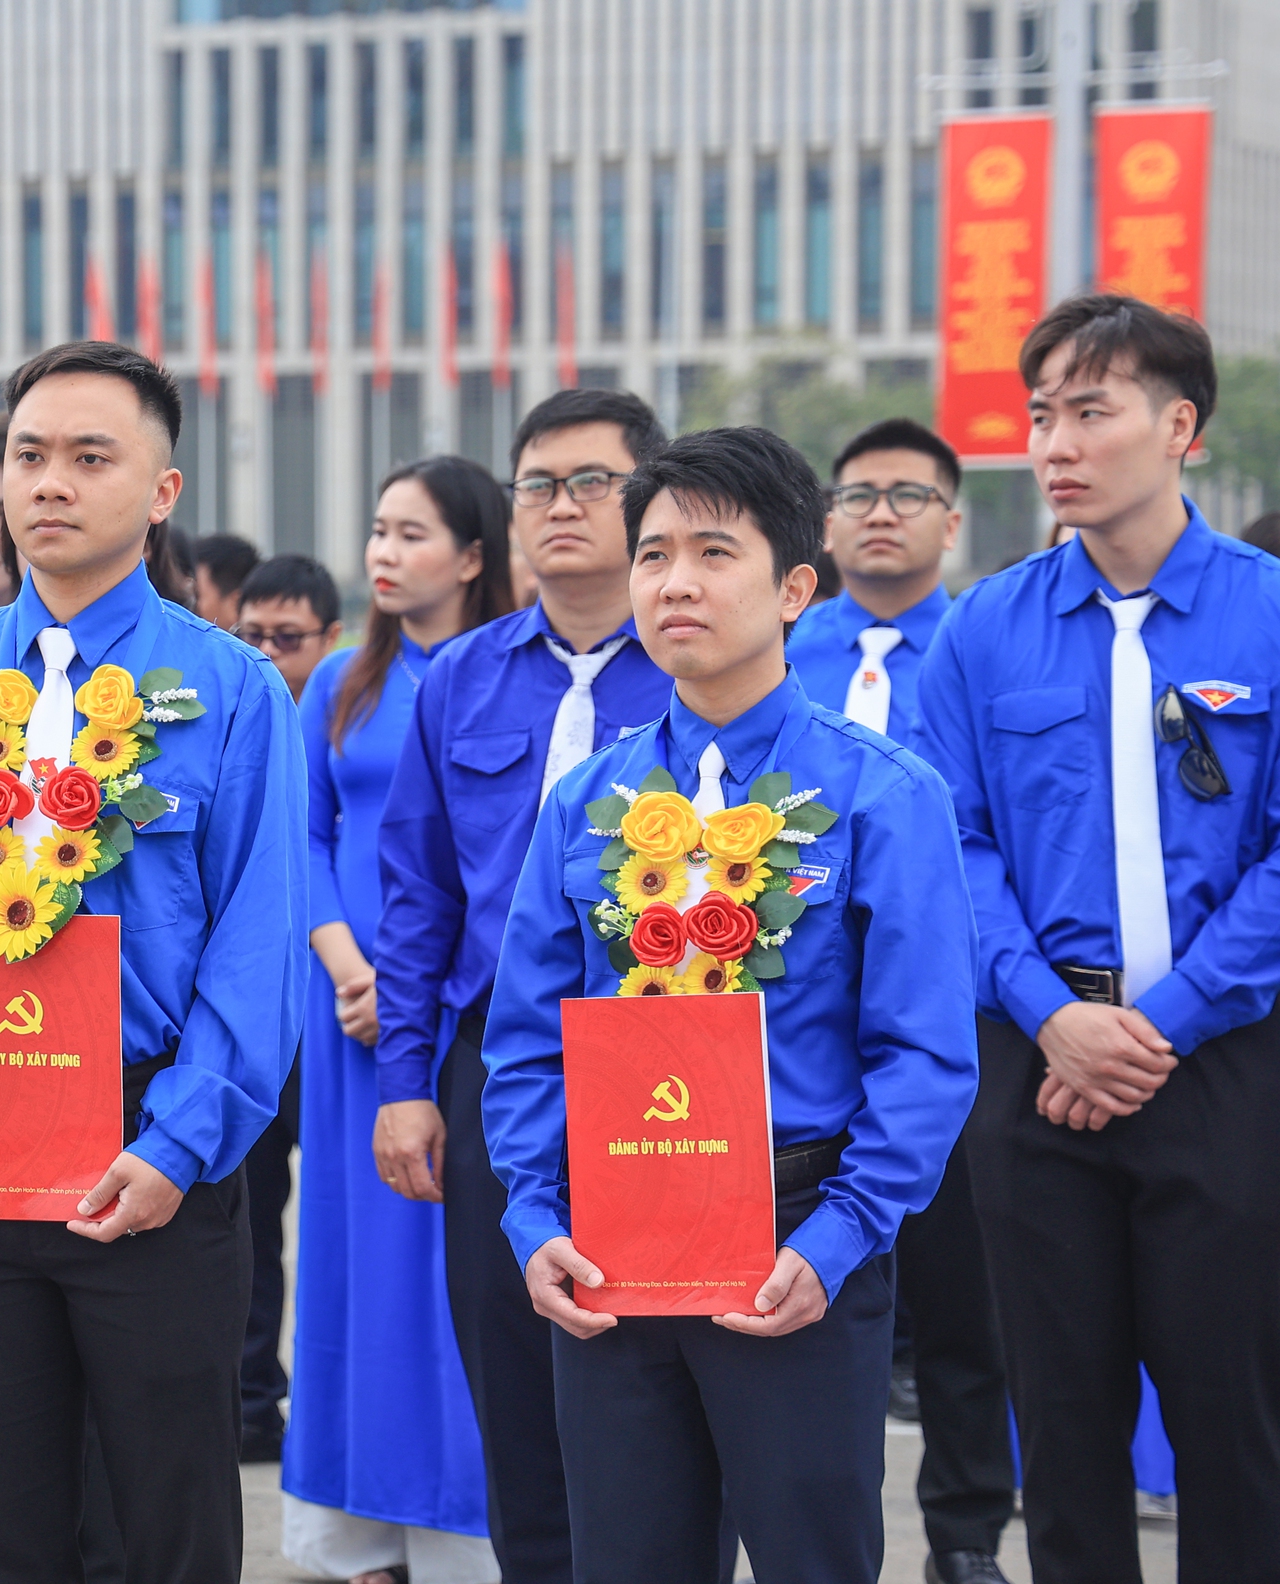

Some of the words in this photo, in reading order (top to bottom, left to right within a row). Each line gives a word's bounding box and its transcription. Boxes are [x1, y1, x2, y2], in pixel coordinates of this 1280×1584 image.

[10, 1051, 24, 1068] BỘ
[26, 1052, 48, 1066] XÂY
[50, 1054, 80, 1069] DỰNG
[608, 1138, 638, 1154] ĐẢNG
[642, 1138, 654, 1154] ỦY
[658, 1139, 672, 1156] BỘ
[674, 1139, 696, 1153] XÂY
[698, 1139, 728, 1155] DỰNG
